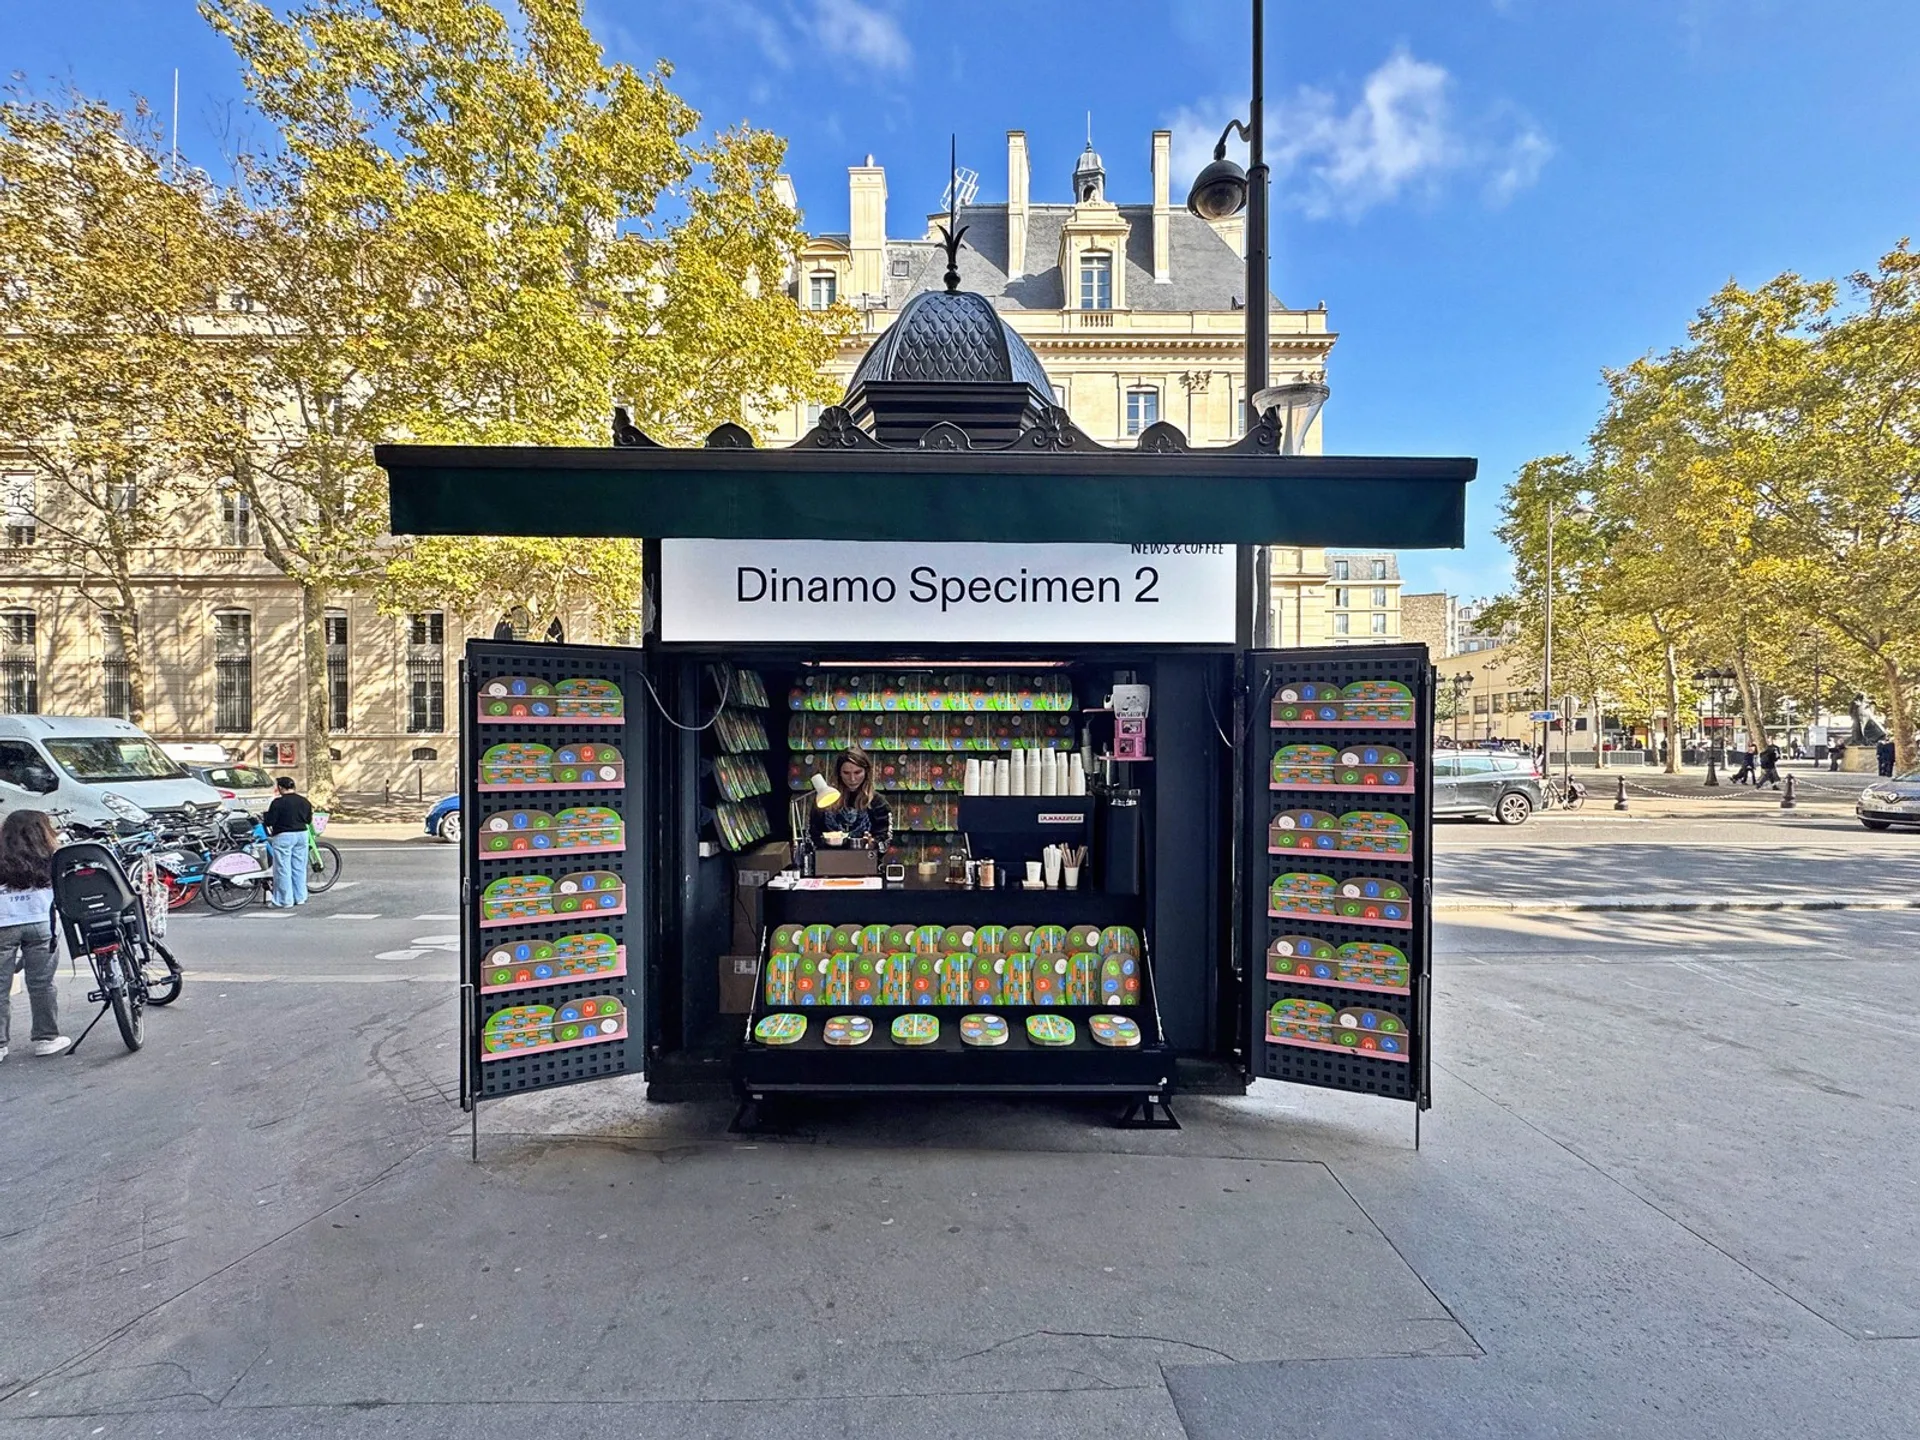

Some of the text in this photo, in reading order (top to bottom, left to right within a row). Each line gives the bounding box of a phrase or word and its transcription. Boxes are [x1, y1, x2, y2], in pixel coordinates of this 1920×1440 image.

[738, 567, 1159, 612] Dinamo Specimen 2
[9, 894, 31, 903] 1985
